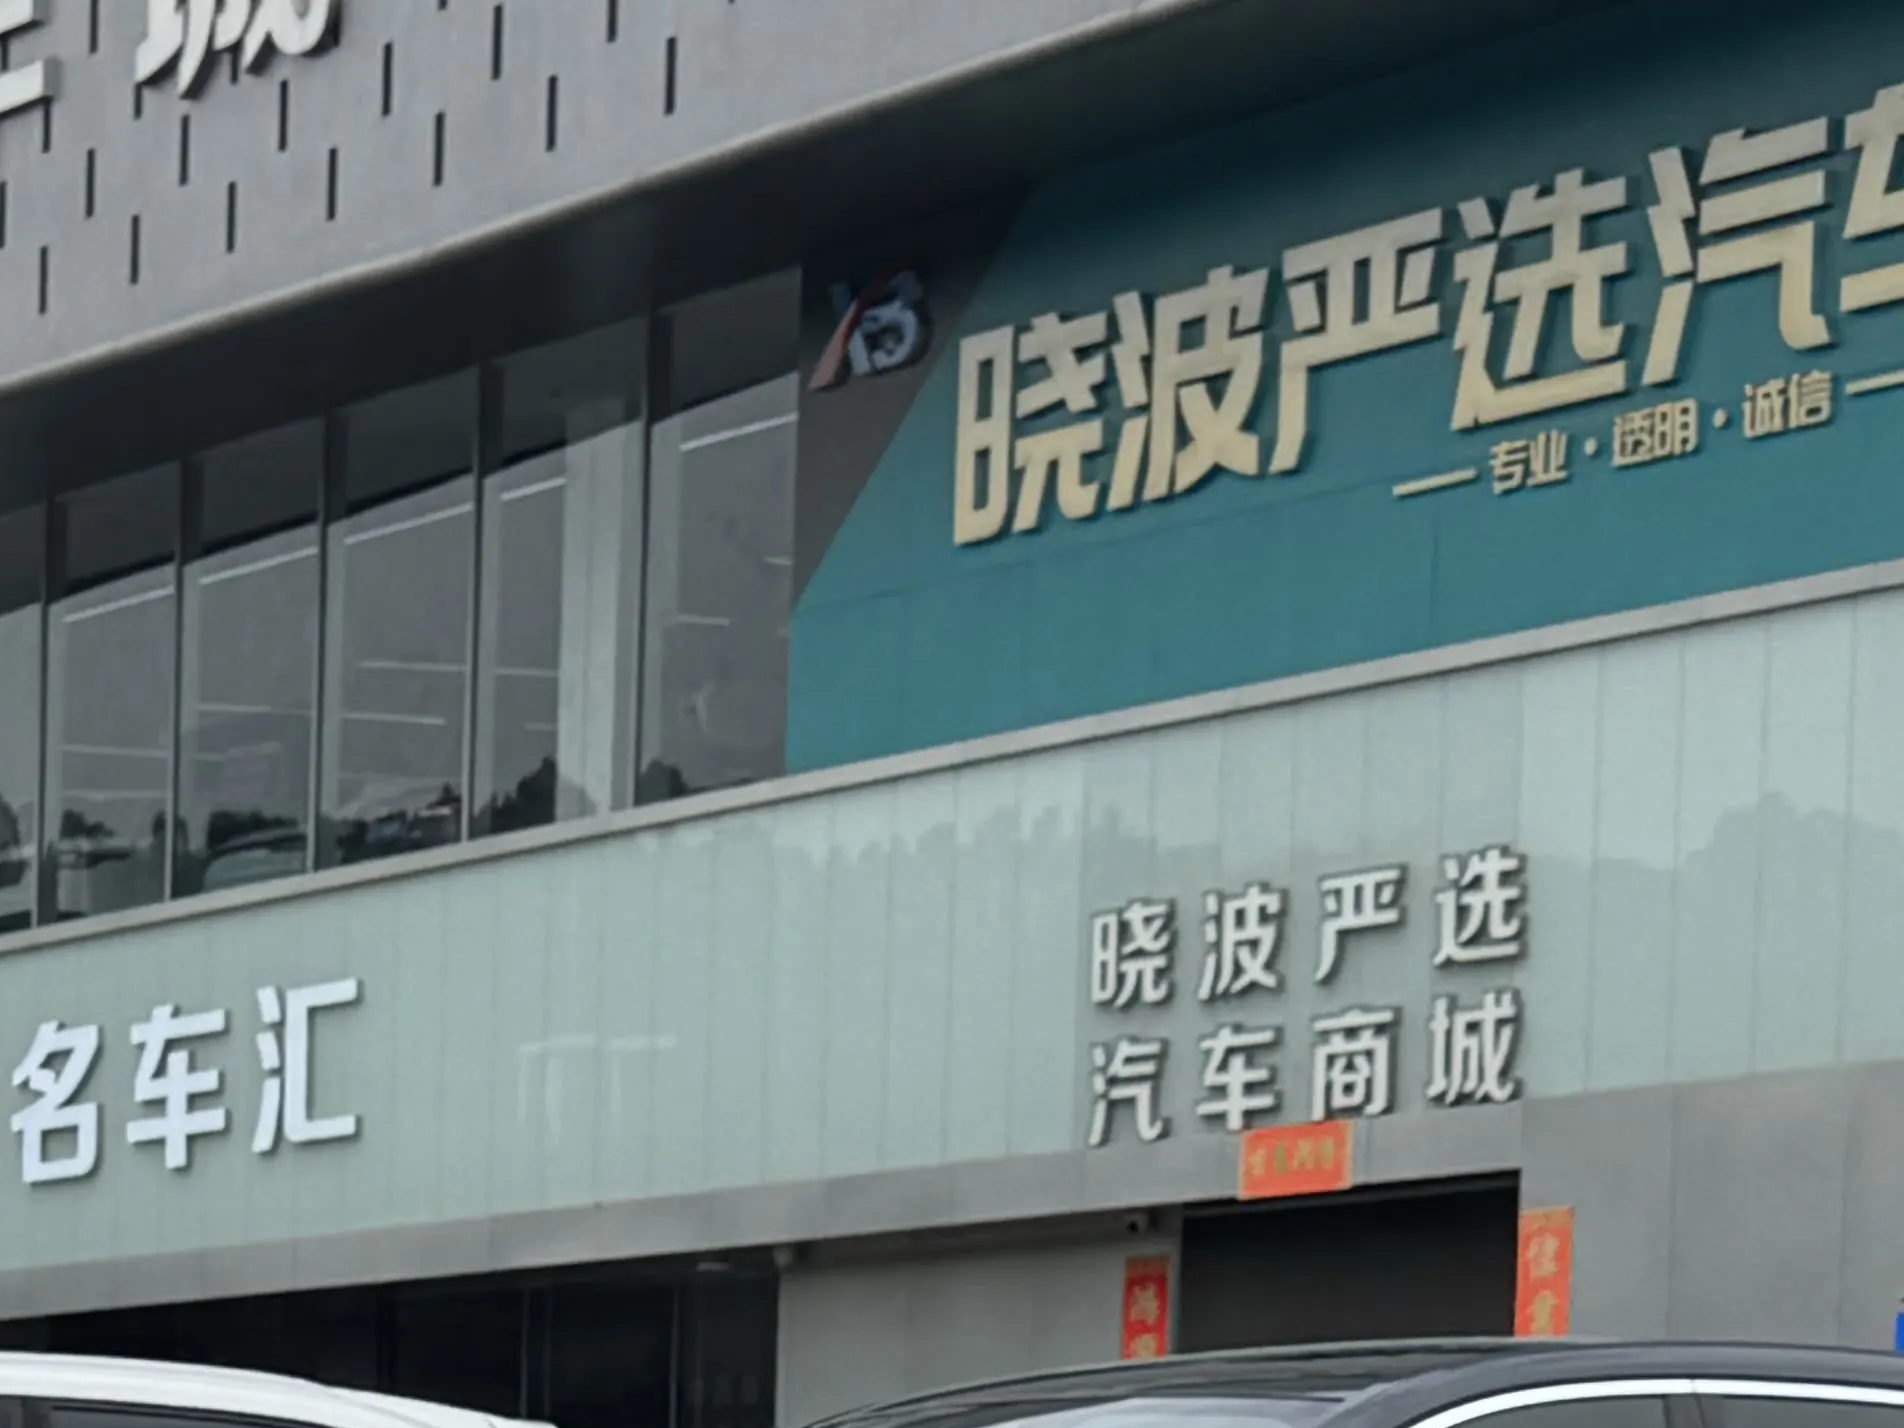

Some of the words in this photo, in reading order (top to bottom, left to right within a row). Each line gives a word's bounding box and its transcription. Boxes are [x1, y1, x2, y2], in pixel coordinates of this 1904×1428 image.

[1089, 845, 1527, 1009] 晓波严选
[1088, 989, 1522, 1147] 汽车商城
